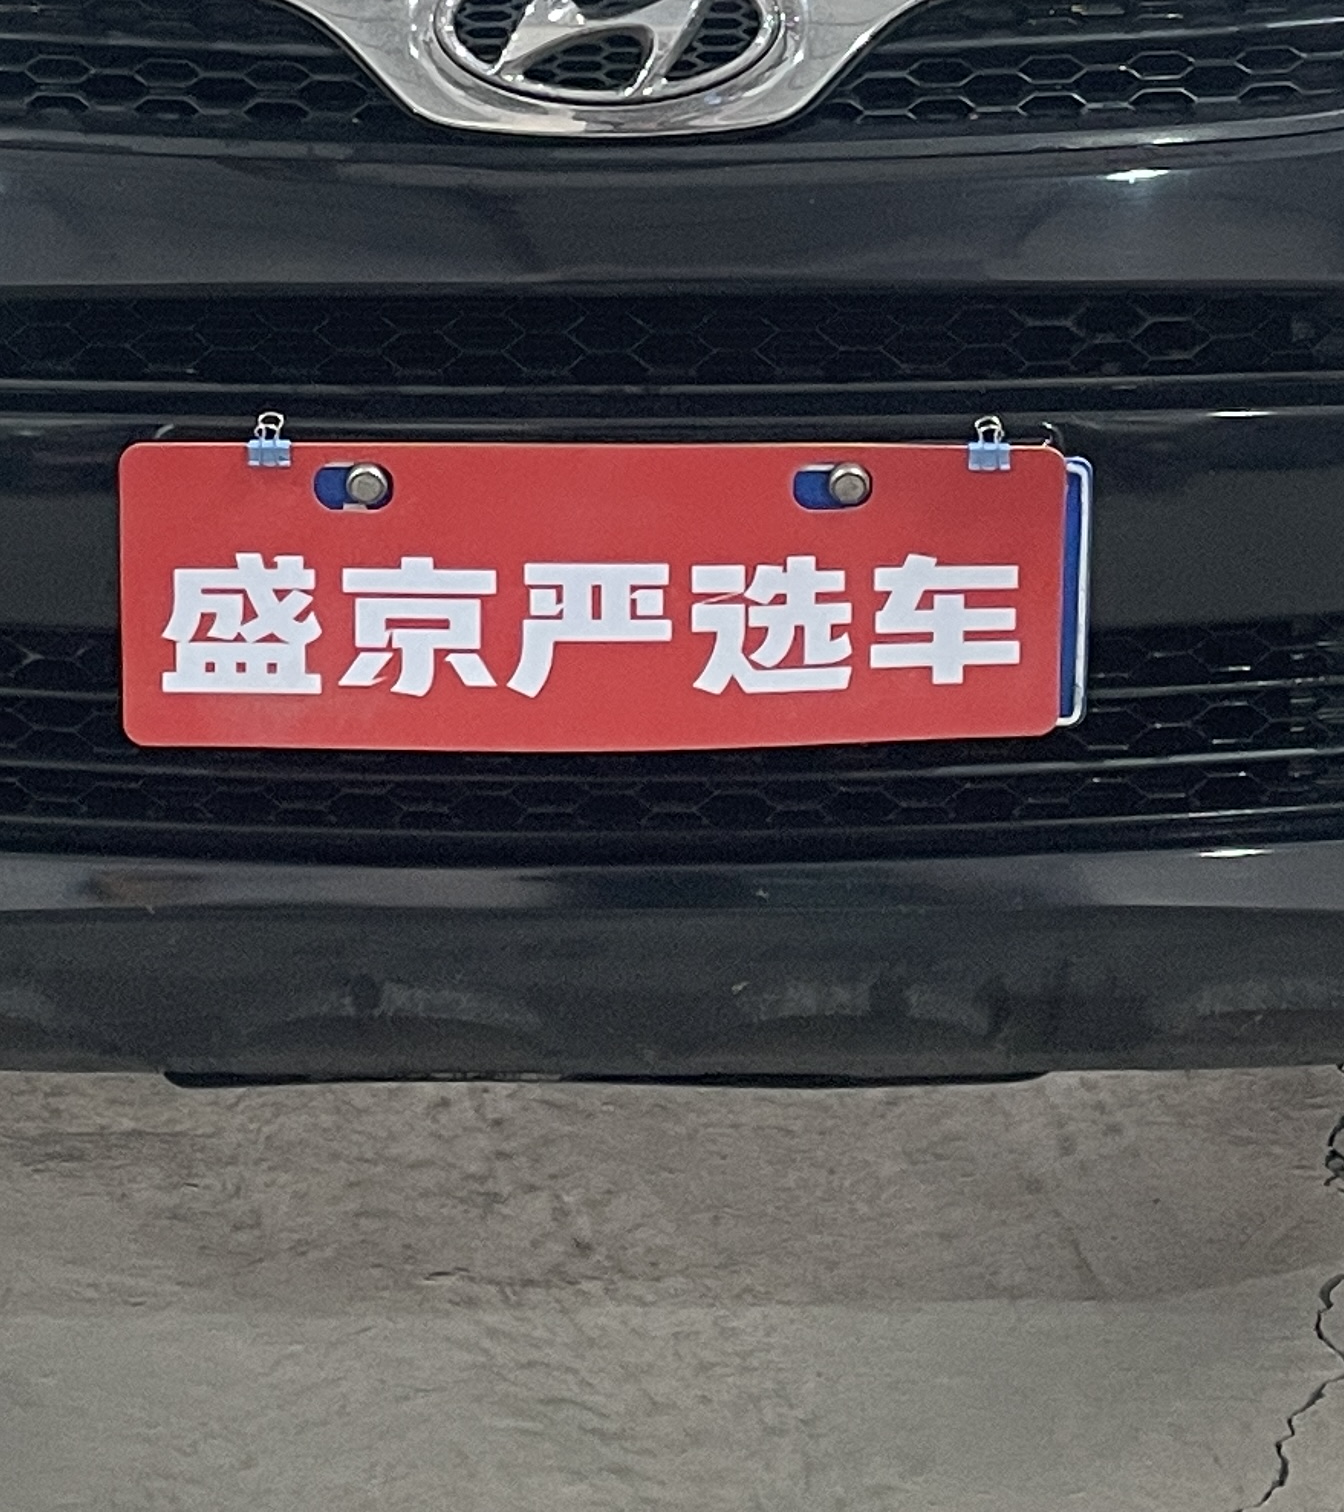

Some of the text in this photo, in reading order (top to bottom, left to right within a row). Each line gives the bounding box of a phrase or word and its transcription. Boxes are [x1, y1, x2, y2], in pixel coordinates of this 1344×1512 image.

[160, 552, 1022, 698] 盛京严选车
